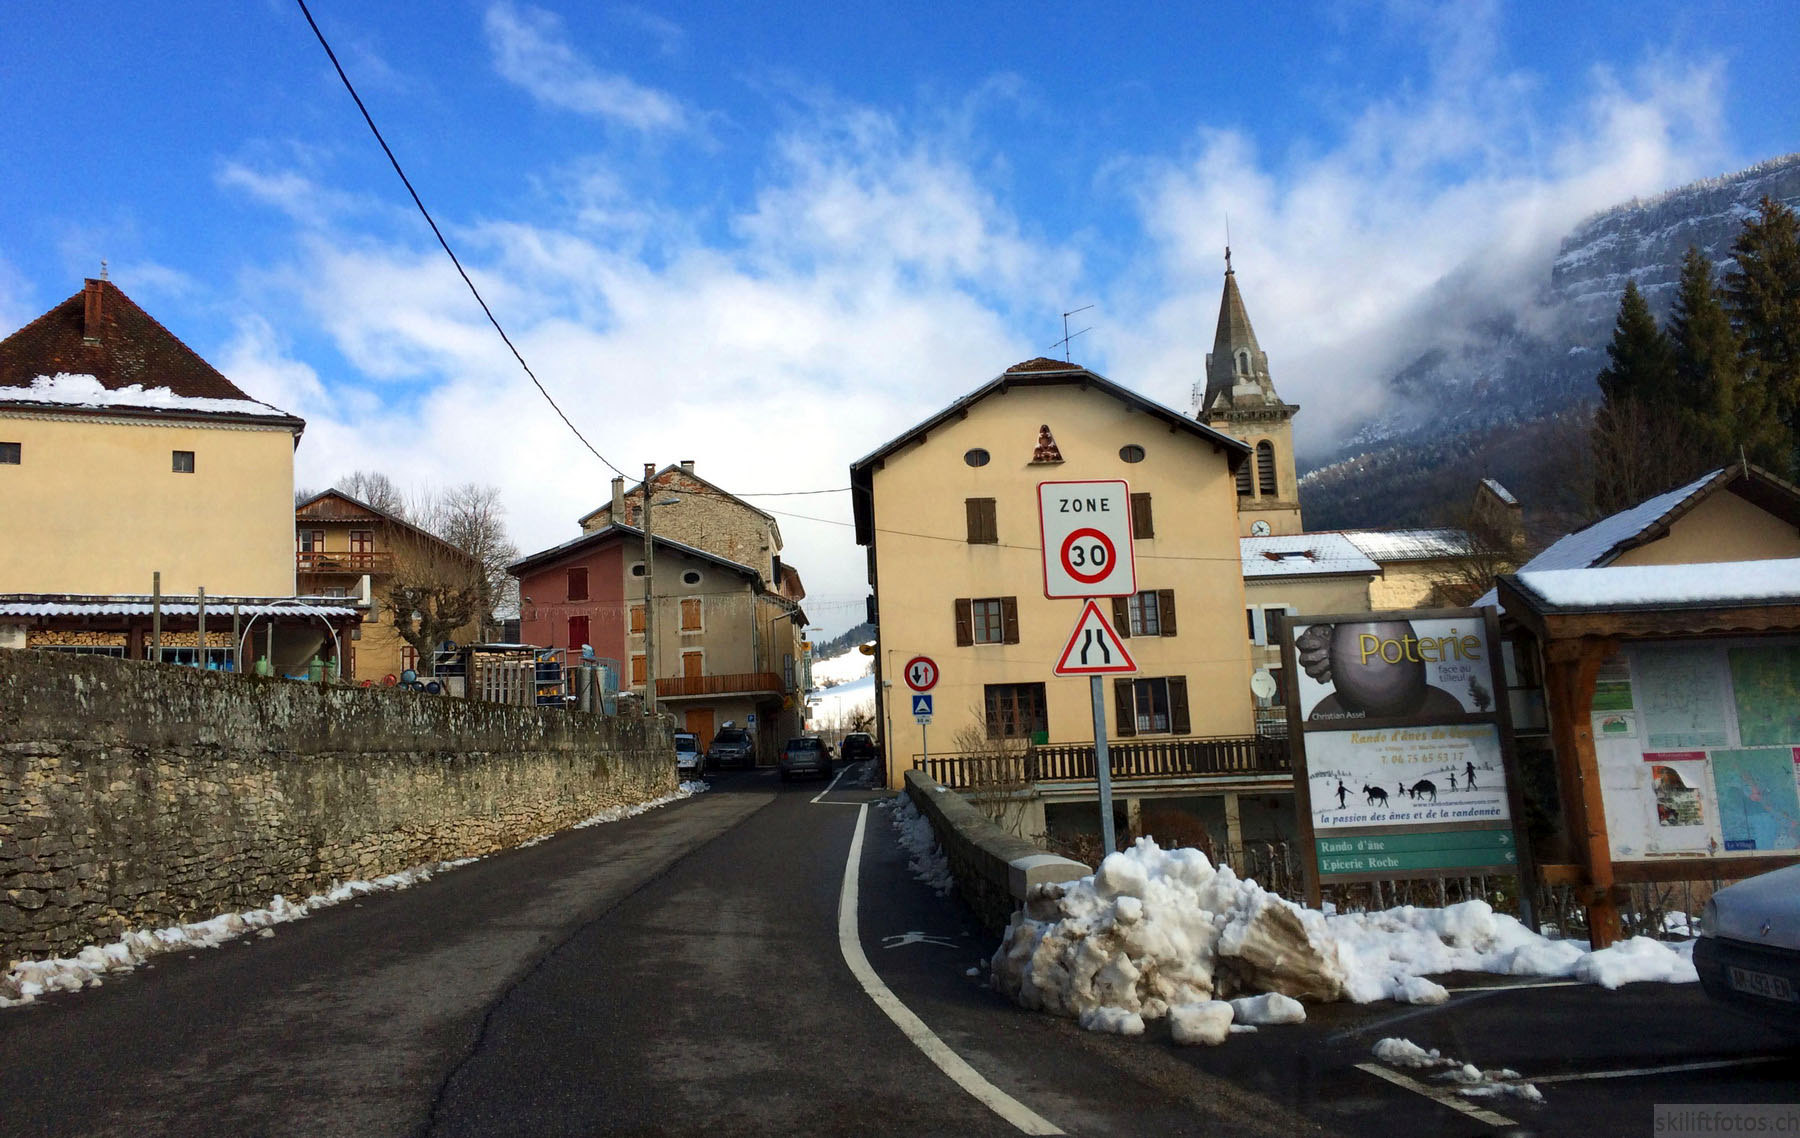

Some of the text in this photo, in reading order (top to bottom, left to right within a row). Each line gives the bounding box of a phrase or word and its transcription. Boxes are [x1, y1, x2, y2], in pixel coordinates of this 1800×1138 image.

[1060, 498, 1110, 513] ZONE
[1071, 544, 1106, 567] 30
[1359, 628, 1482, 665] Poterie
[1438, 665, 1472, 674] face au
[1311, 711, 1366, 721] Christian Assel
[1351, 732, 1387, 744] Rando
[1321, 808, 1501, 825] la passion des ânes et de la randonnée
[1321, 841, 1353, 852] Rando
[1322, 857, 1399, 872] Epicerie Roche
